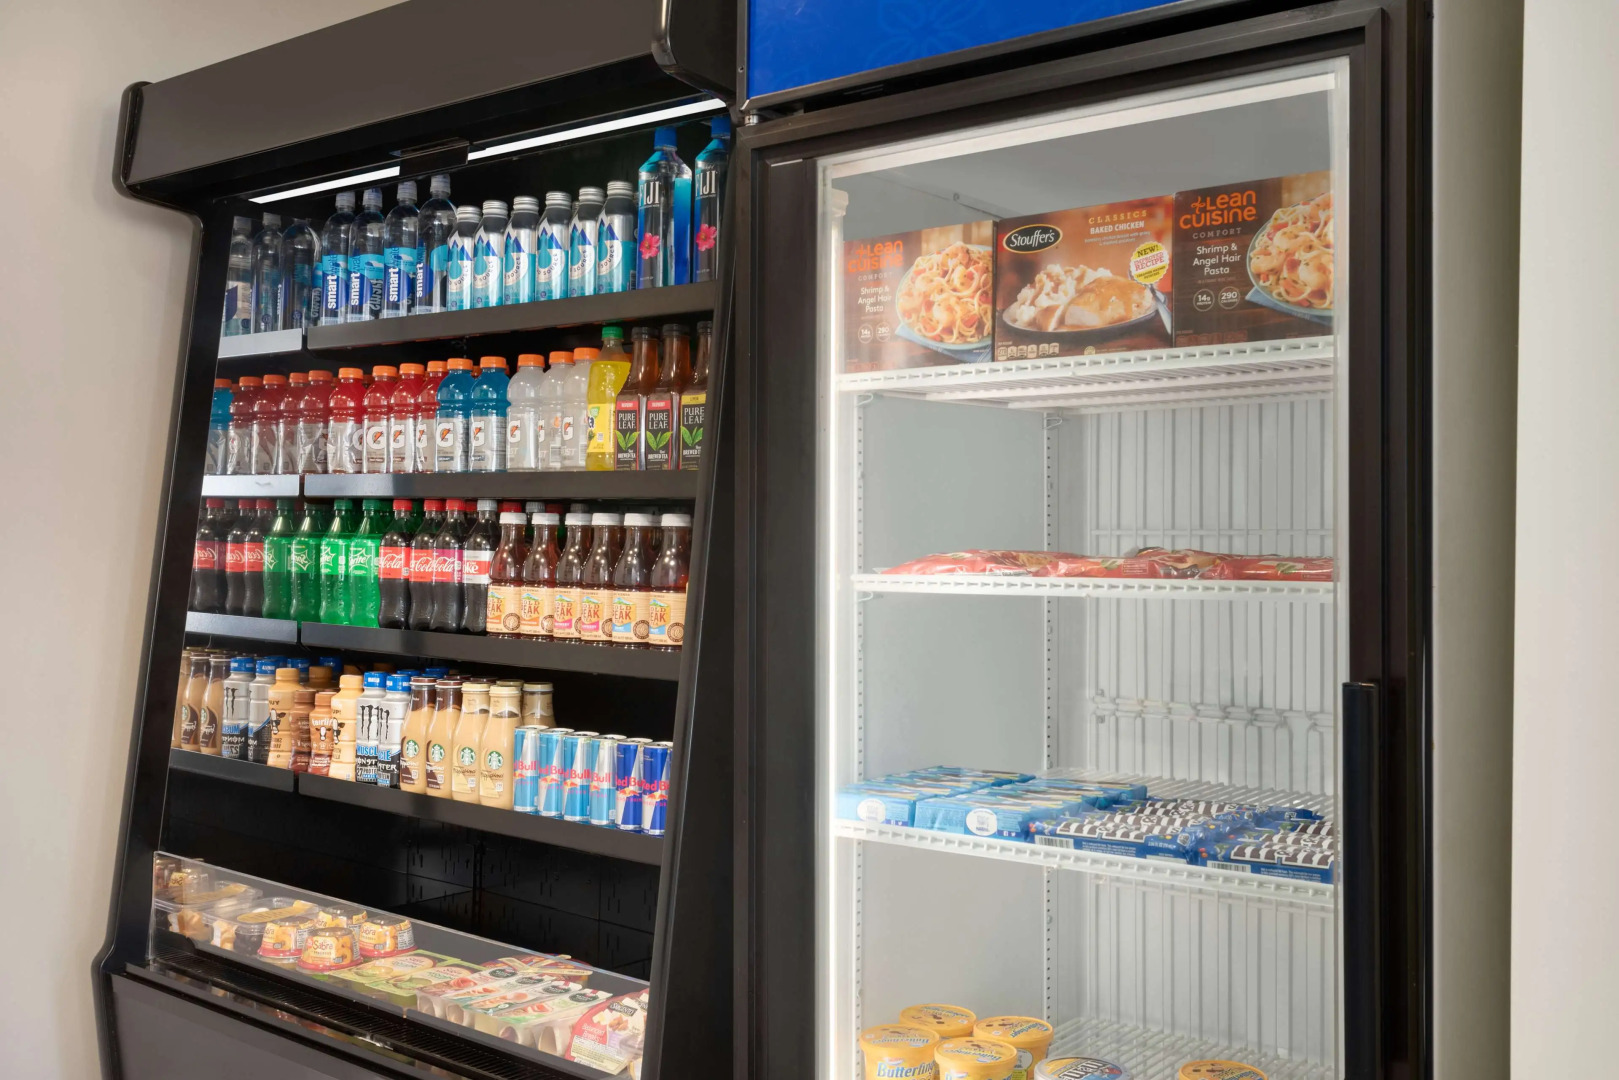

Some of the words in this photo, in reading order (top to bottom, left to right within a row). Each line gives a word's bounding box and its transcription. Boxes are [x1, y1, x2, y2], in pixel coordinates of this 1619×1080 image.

[695, 170, 717, 197] FIJI
[639, 181, 659, 207] FIJI
[1089, 210, 1147, 224] CLASSICS
[1090, 225, 1113, 234] BAKED
[1114, 221, 1145, 231] CHICKEN
[1010, 229, 1055, 247] Stouffer's
[1192, 228, 1242, 239] COMFORT
[1137, 245, 1158, 257] NEW!
[1196, 246, 1229, 255] Shrimp
[1230, 242, 1238, 251] &
[1135, 257, 1165, 272] RECIPE
[1193, 256, 1219, 267] Angel
[1221, 253, 1241, 263] Hair
[1204, 266, 1230, 276] Pasta
[860, 287, 883, 296] Shrimp
[1221, 291, 1238, 300] 290
[858, 296, 876, 306] Angel
[865, 305, 885, 313] Pasta
[618, 413, 636, 421] PURE
[649, 413, 668, 421] PURE
[684, 407, 705, 416] PURE
[618, 421, 636, 430] LEAF
[649, 421, 668, 430] LEAF
[684, 415, 704, 425] LEAF
[312, 718, 335, 726] fairlif
[356, 744, 378, 756] MUSCL
[313, 938, 335, 952] Sabra
[877, 1060, 936, 1078] Butterfin
